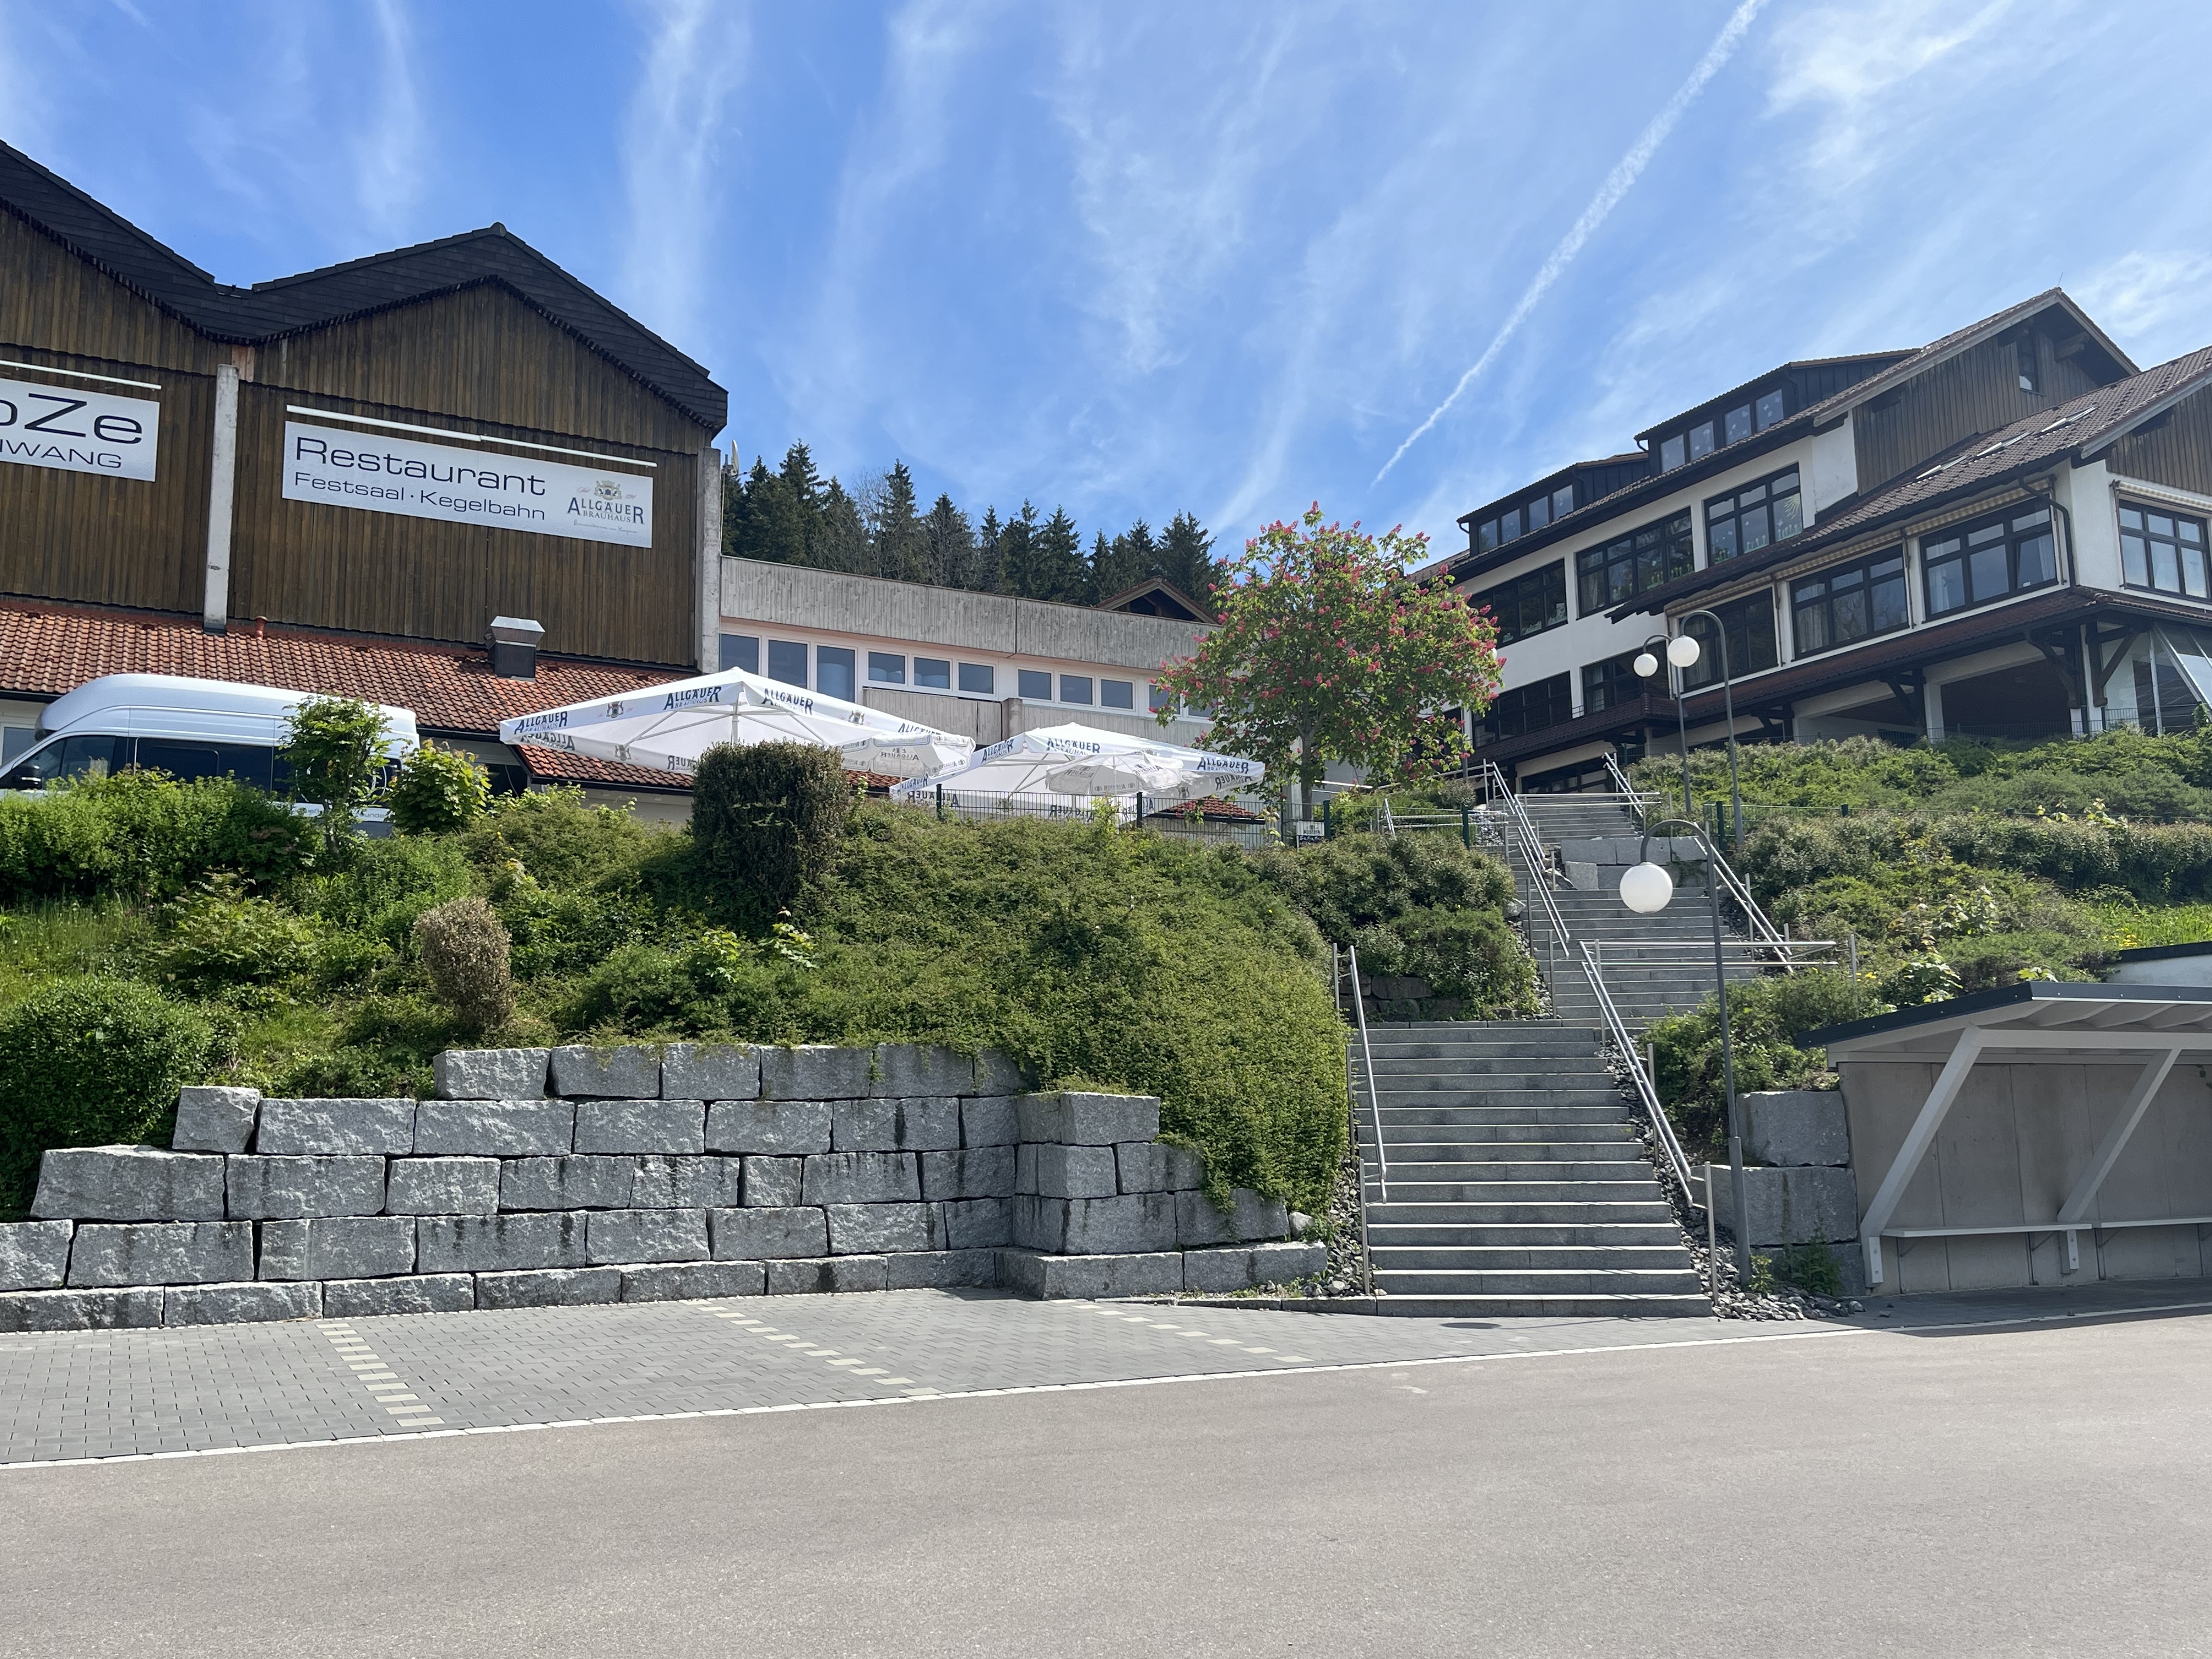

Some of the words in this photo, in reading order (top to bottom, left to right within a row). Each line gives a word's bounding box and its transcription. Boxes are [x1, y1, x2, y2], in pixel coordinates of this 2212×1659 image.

[0, 439, 122, 469] WANG
[296, 437, 545, 495] Restaurant
[295, 472, 404, 500] Festsaal
[421, 490, 545, 520] Kegelbahn
[566, 497, 645, 525] ALLGÄUER
[583, 510, 631, 523] BRAUHAUS
[514, 711, 568, 735] ALLGÄUER
